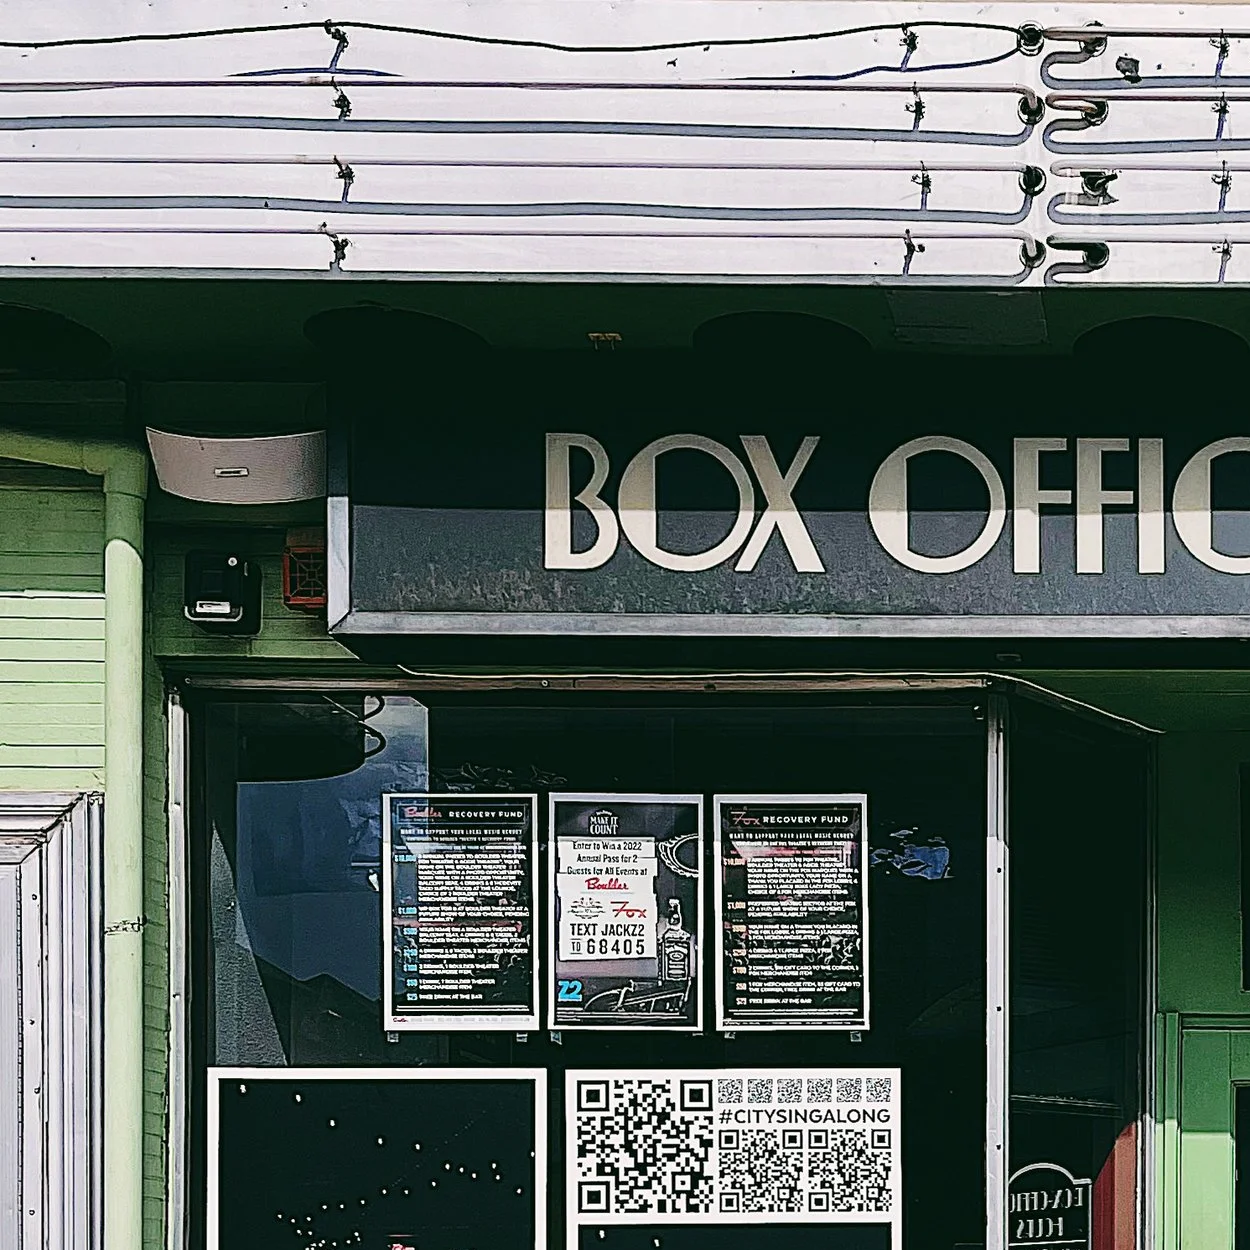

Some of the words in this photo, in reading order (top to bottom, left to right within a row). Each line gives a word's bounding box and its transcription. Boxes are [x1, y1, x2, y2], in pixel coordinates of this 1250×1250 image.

[544, 432, 826, 574] BOX
[590, 816, 610, 825] MAKE
[610, 816, 618, 825] IT
[590, 825, 618, 835] COUNT
[573, 842, 592, 850] Enter
[593, 842, 600, 850] to
[602, 842, 616, 850] Win
[617, 842, 621, 850] a
[623, 842, 642, 850] 2022
[577, 854, 600, 863] Annual
[603, 854, 619, 863] Pass
[621, 854, 630, 863] for
[632, 854, 638, 863] 2
[567, 866, 591, 875] Guests
[593, 866, 603, 875] for
[605, 866, 614, 875] All
[616, 866, 635, 875] Events
[637, 866, 647, 875] at
[585, 877, 629, 890] Boulder
[570, 923, 598, 936] TEXT
[601, 923, 645, 936] JACKZ2
[571, 942, 581, 952] TO
[587, 939, 645, 955] 68405
[558, 980, 582, 1001] Z2
[719, 1106, 891, 1125] #CITYSINGALONG
